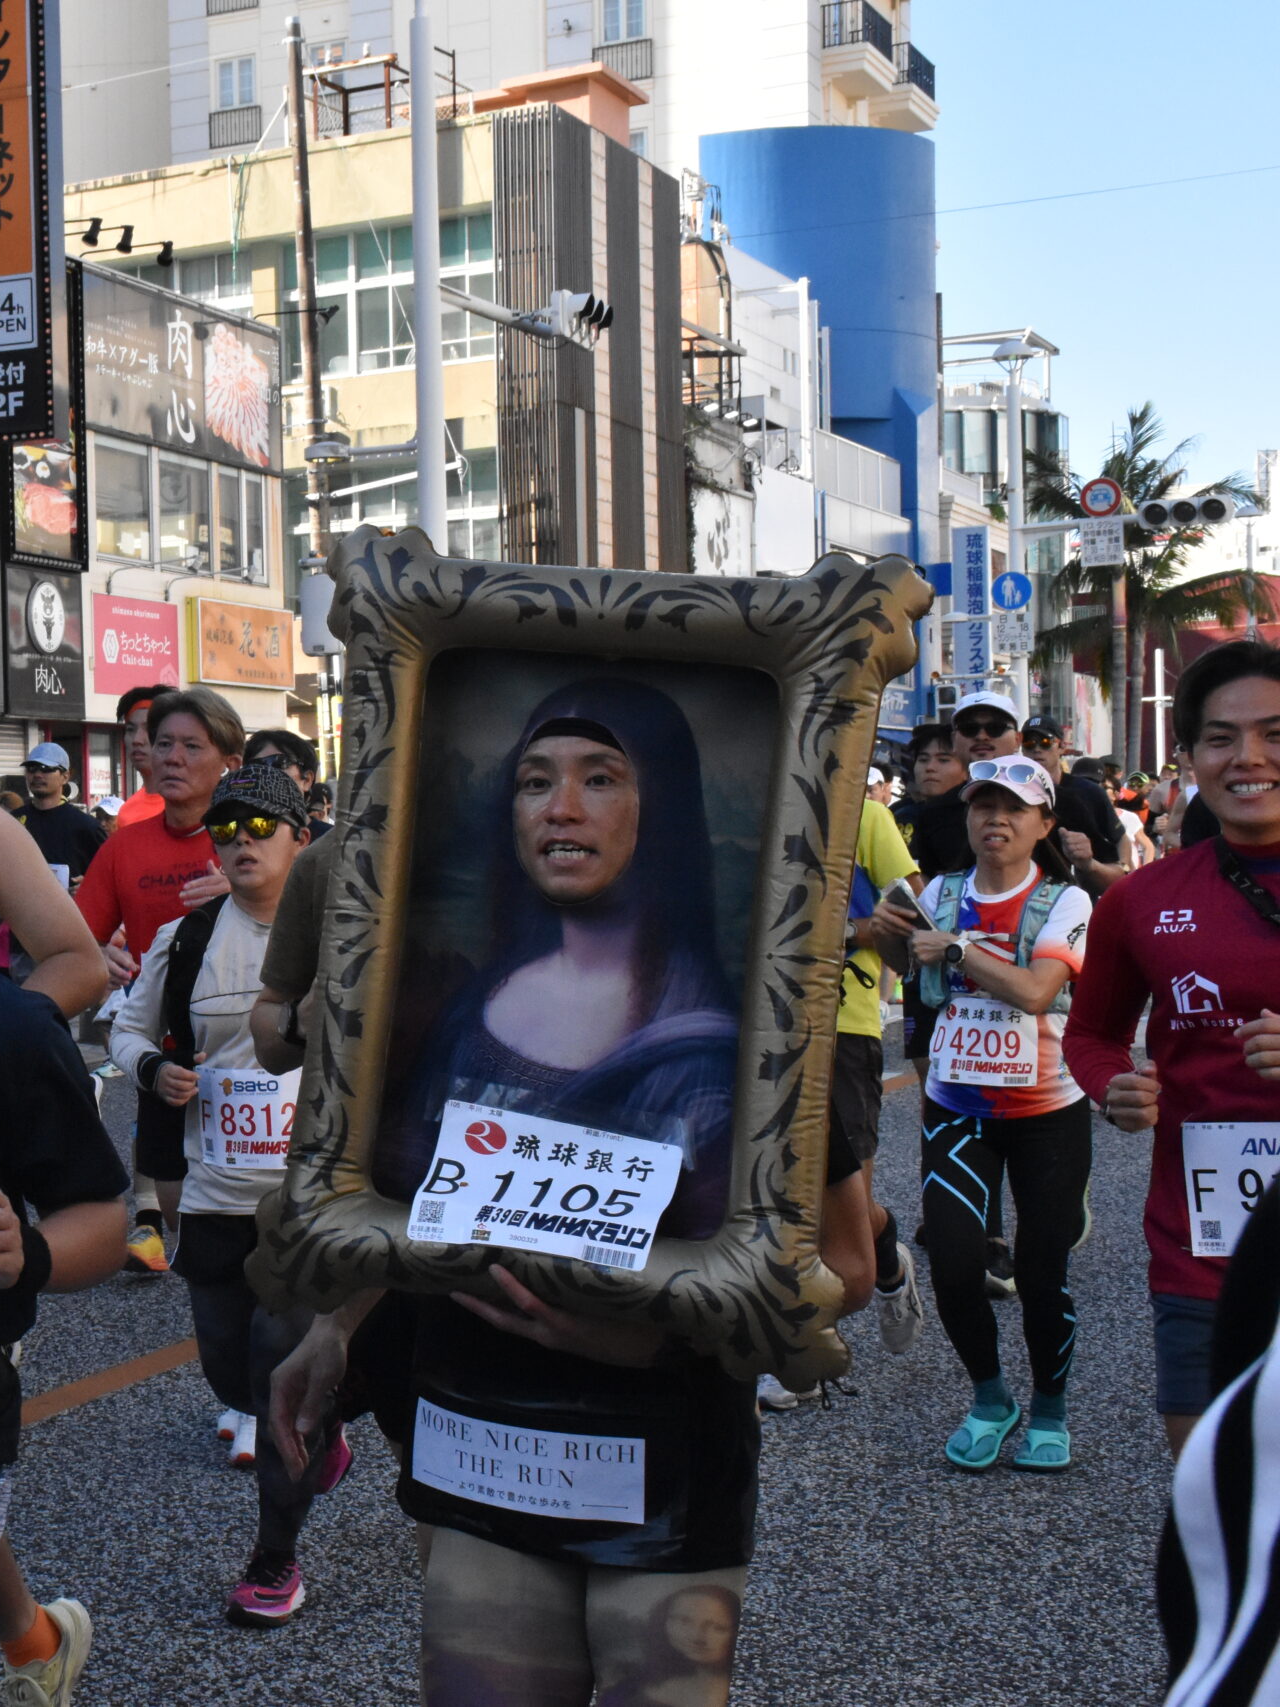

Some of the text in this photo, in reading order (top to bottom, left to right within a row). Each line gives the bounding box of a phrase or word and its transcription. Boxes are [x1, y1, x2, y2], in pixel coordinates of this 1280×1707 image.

[958, 1007, 1022, 1023] 琉球銀行
[933, 1026, 1021, 1058] D 4209
[220, 1102, 297, 1136] 8312
[512, 1134, 655, 1182] 琉球銀行
[422, 1158, 641, 1218] B 1105
[1192, 1169, 1218, 1213] F
[421, 1406, 636, 1464] MORE NICE RICH
[454, 1449, 575, 1489] THE RUN
[458, 1480, 572, 1510] より素敵で豊かな歩みを
